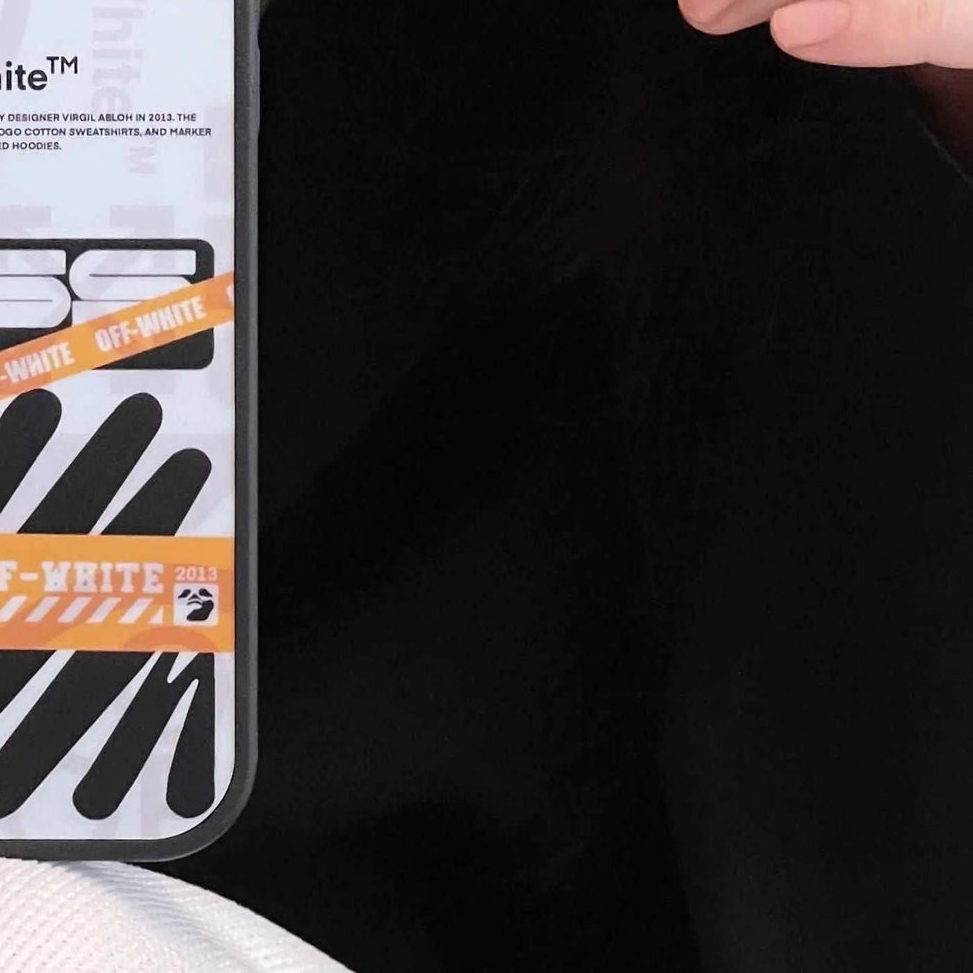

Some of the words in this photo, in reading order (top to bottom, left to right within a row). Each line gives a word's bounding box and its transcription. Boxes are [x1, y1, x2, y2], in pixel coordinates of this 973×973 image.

[7, 113, 60, 122] DESIGNER
[62, 113, 96, 122] VIRGIL
[97, 113, 133, 122] ABLOH
[135, 113, 146, 122] IN
[148, 113, 175, 122] 2013.
[177, 113, 197, 122] THE
[24, 127, 67, 136] COTTON
[68, 127, 142, 137] SWEATSHIRTS,
[144, 127, 167, 136] AND
[169, 127, 212, 136] MARKER
[12, 141, 62, 150] HOODIES.
[94, 295, 207, 353] OFF-WHITE
[175, 566, 219, 582] 2013
